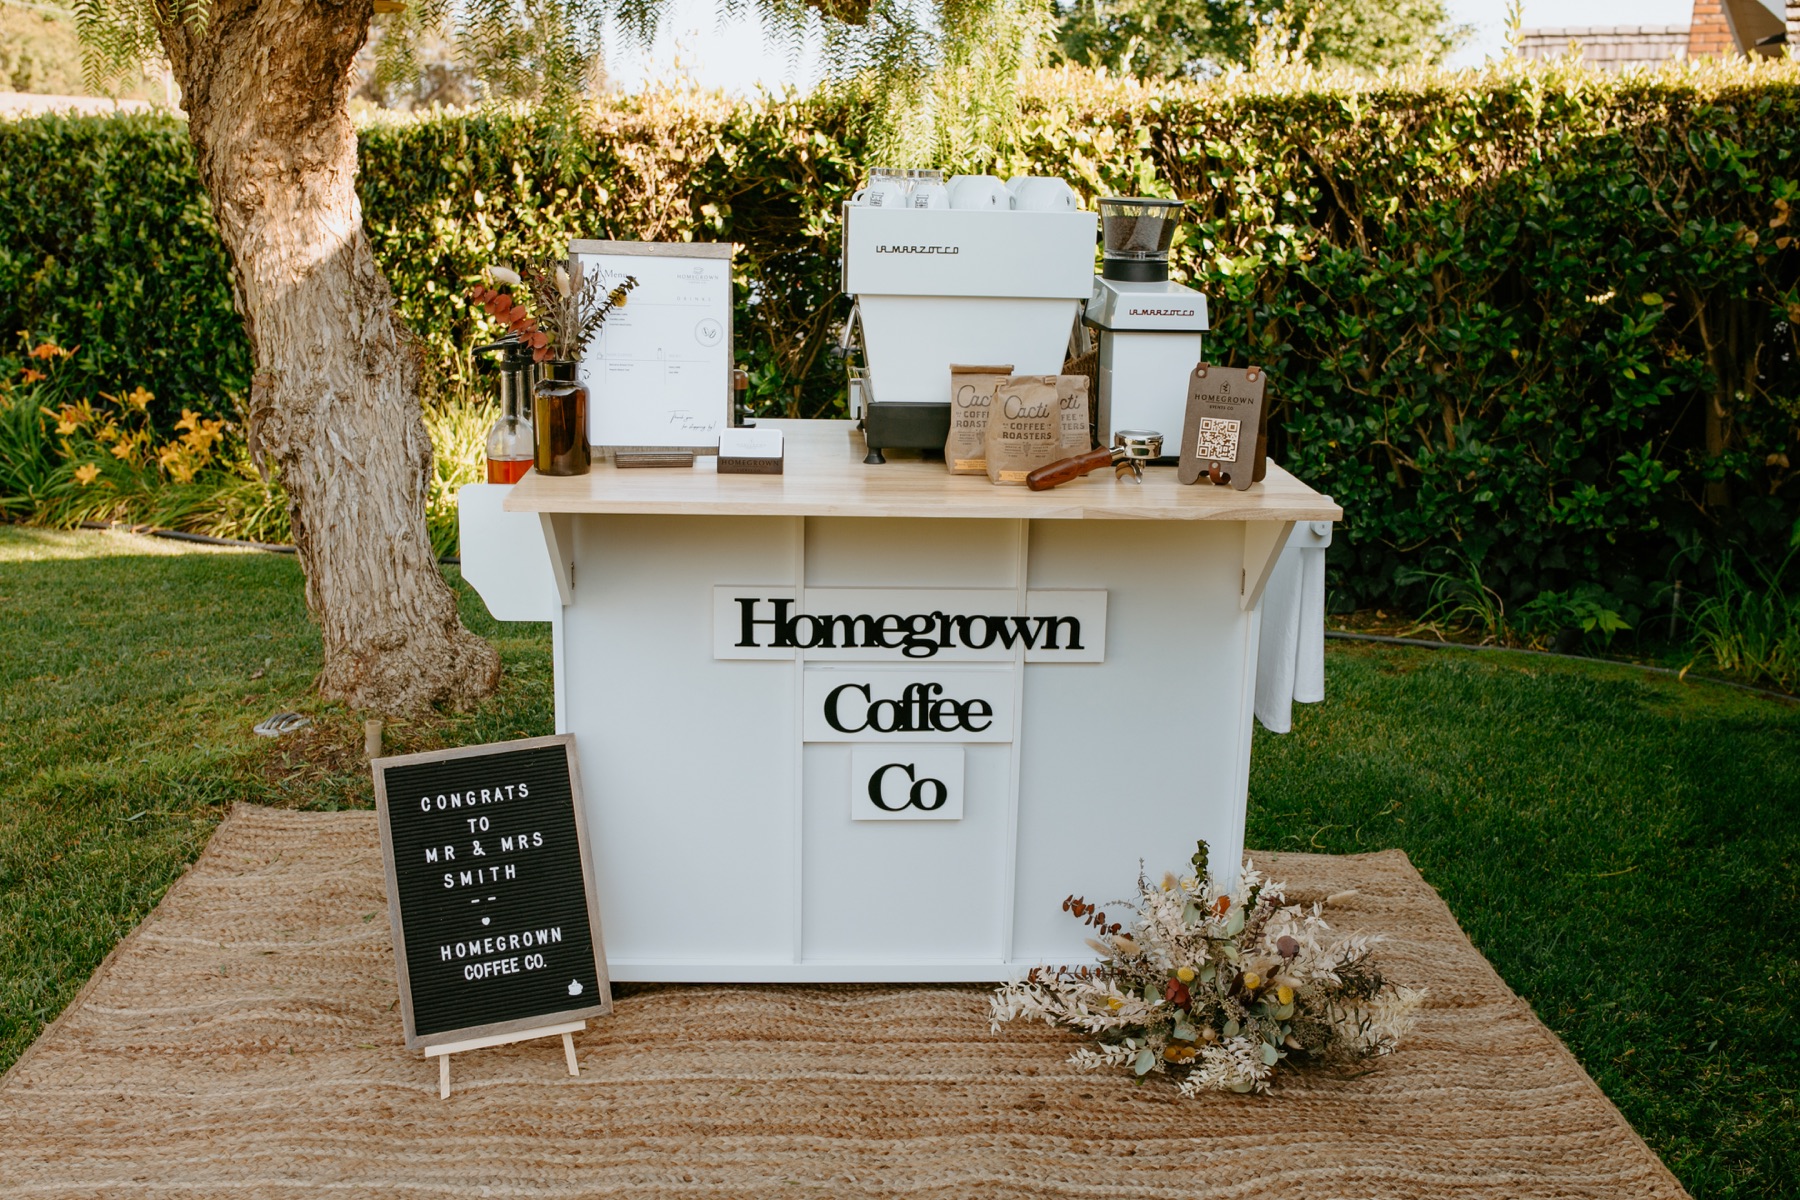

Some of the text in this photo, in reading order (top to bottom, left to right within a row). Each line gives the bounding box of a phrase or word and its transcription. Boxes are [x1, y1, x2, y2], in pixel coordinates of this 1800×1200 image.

[892, 245, 959, 255] MARZOCCO
[1003, 394, 1050, 420] Cacti
[1194, 393, 1255, 405] HOMEGROWN
[1002, 432, 1052, 440] ROASTERS
[1010, 422, 1046, 431] COFFEE
[734, 598, 1085, 659] Homegrown
[824, 682, 993, 733] Coffee
[420, 783, 529, 812] CONGRATS
[868, 763, 948, 812] Co
[466, 816, 490, 834] TO
[425, 831, 543, 864] MR & MRS
[443, 864, 517, 889] SMITH
[440, 926, 562, 962] HOMEGROWN
[464, 953, 547, 980] COFFEE CO.
